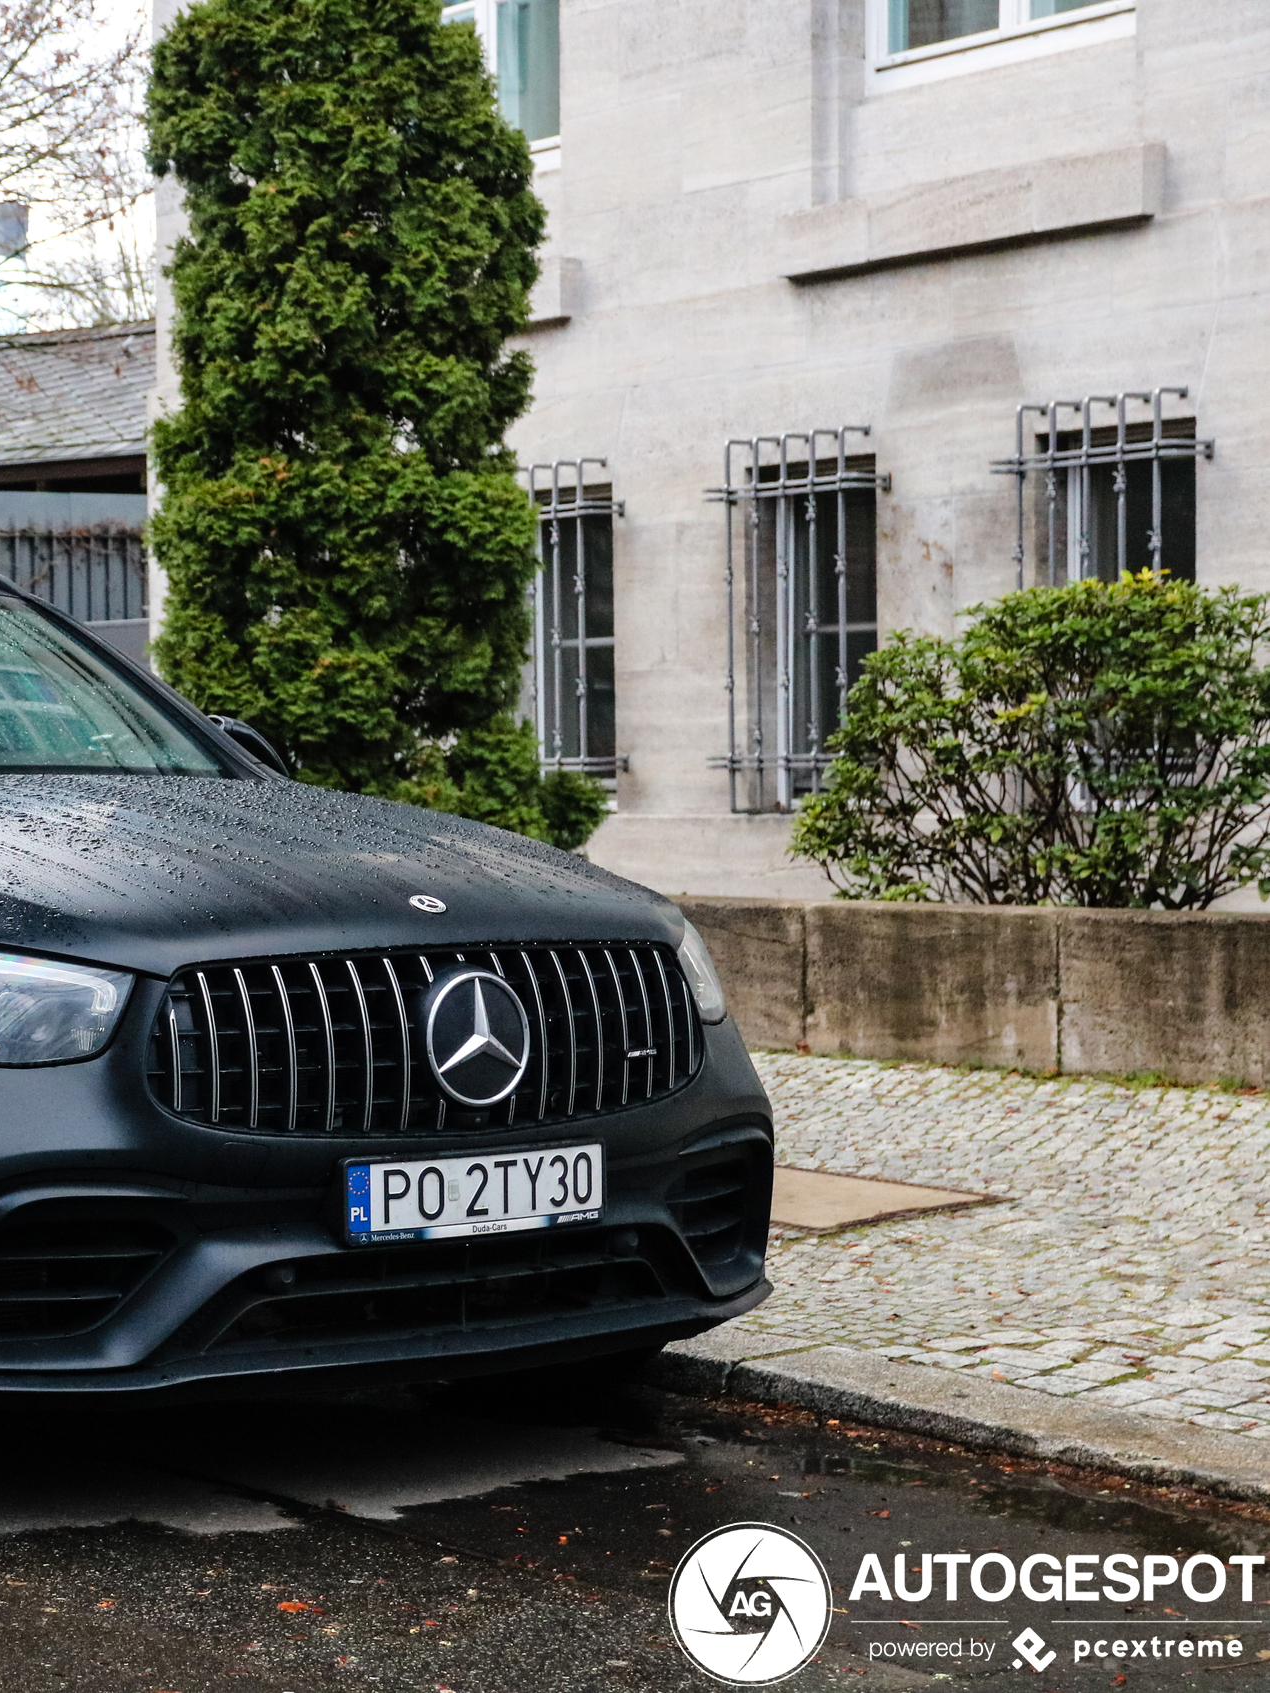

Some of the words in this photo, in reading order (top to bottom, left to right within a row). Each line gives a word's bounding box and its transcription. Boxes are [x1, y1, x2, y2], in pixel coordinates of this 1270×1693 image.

[383, 1166, 445, 1224] PO
[466, 1151, 592, 1217] 2TY30
[350, 1207, 368, 1222] PL
[571, 1210, 598, 1221] AMG
[472, 1222, 508, 1233] Duda-Cars
[370, 1231, 415, 1242] Mercedes-Benz
